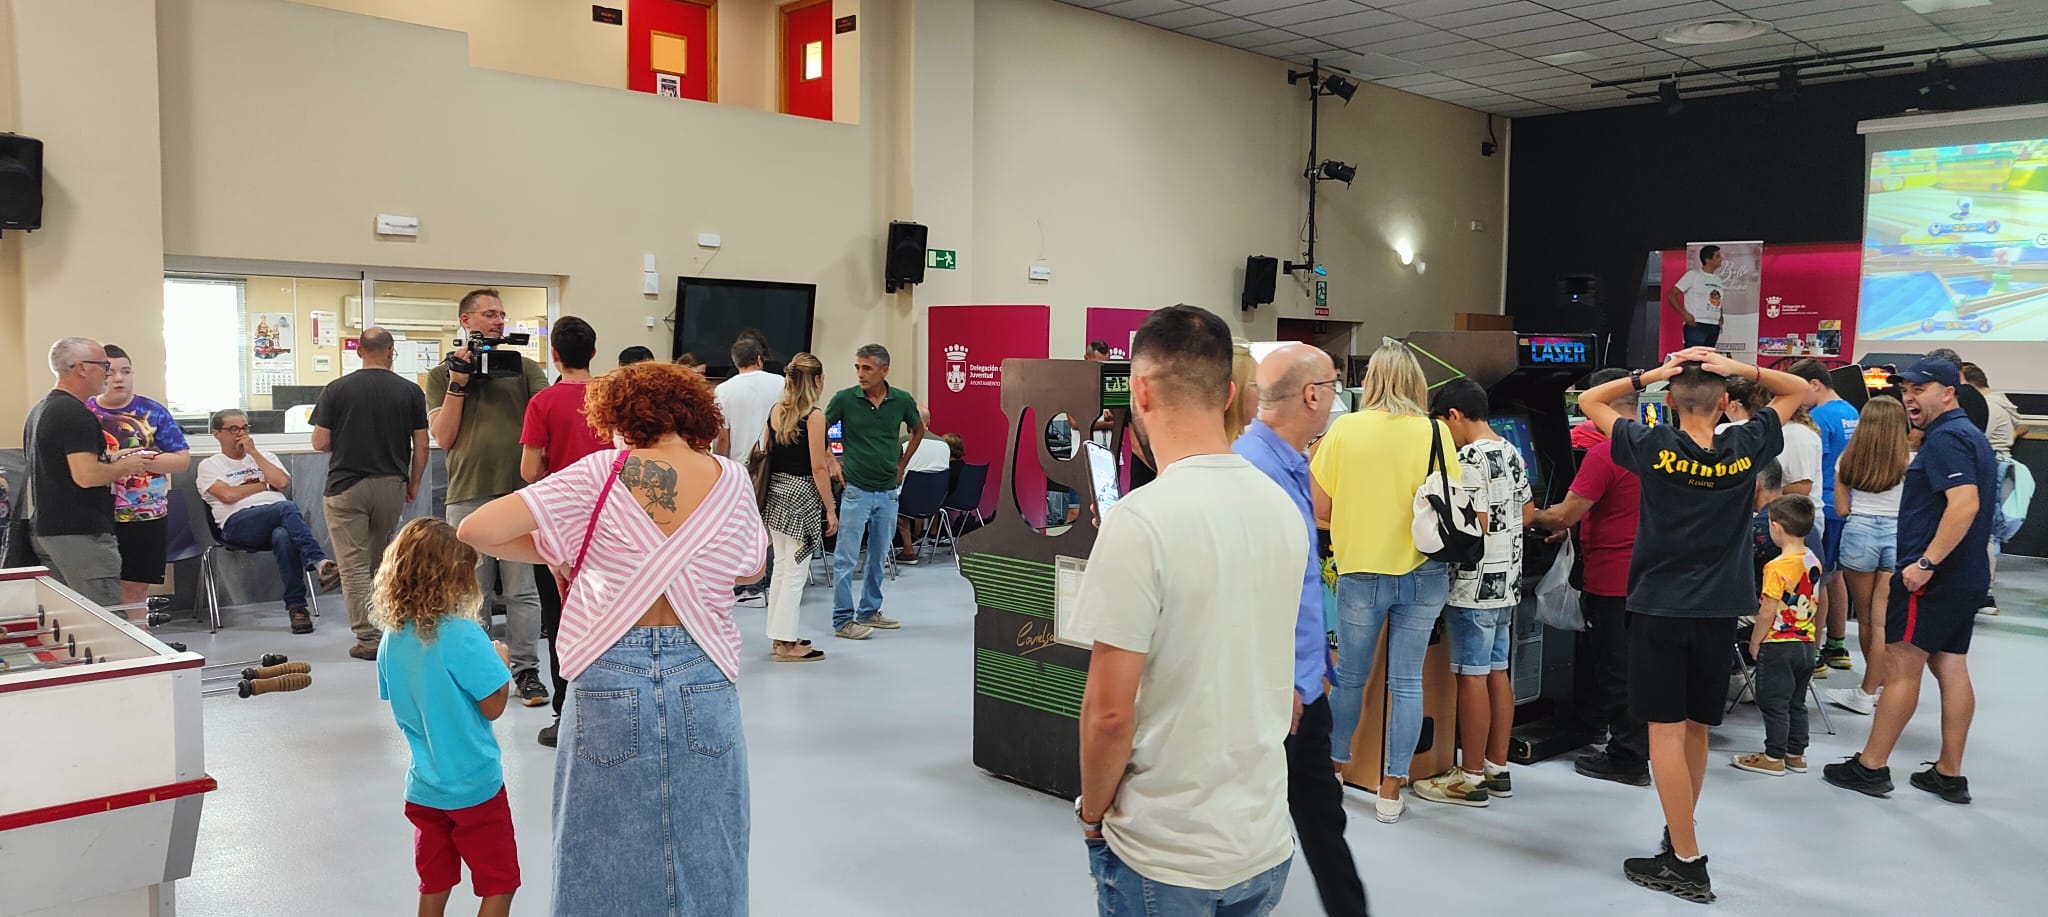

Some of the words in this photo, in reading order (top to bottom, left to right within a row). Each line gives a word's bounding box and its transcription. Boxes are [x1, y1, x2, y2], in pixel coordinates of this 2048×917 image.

[1530, 341, 1586, 363] LASER
[969, 363, 999, 373] Delegación
[1652, 449, 1752, 477] Rainbow
[1688, 479, 1714, 488] Rising
